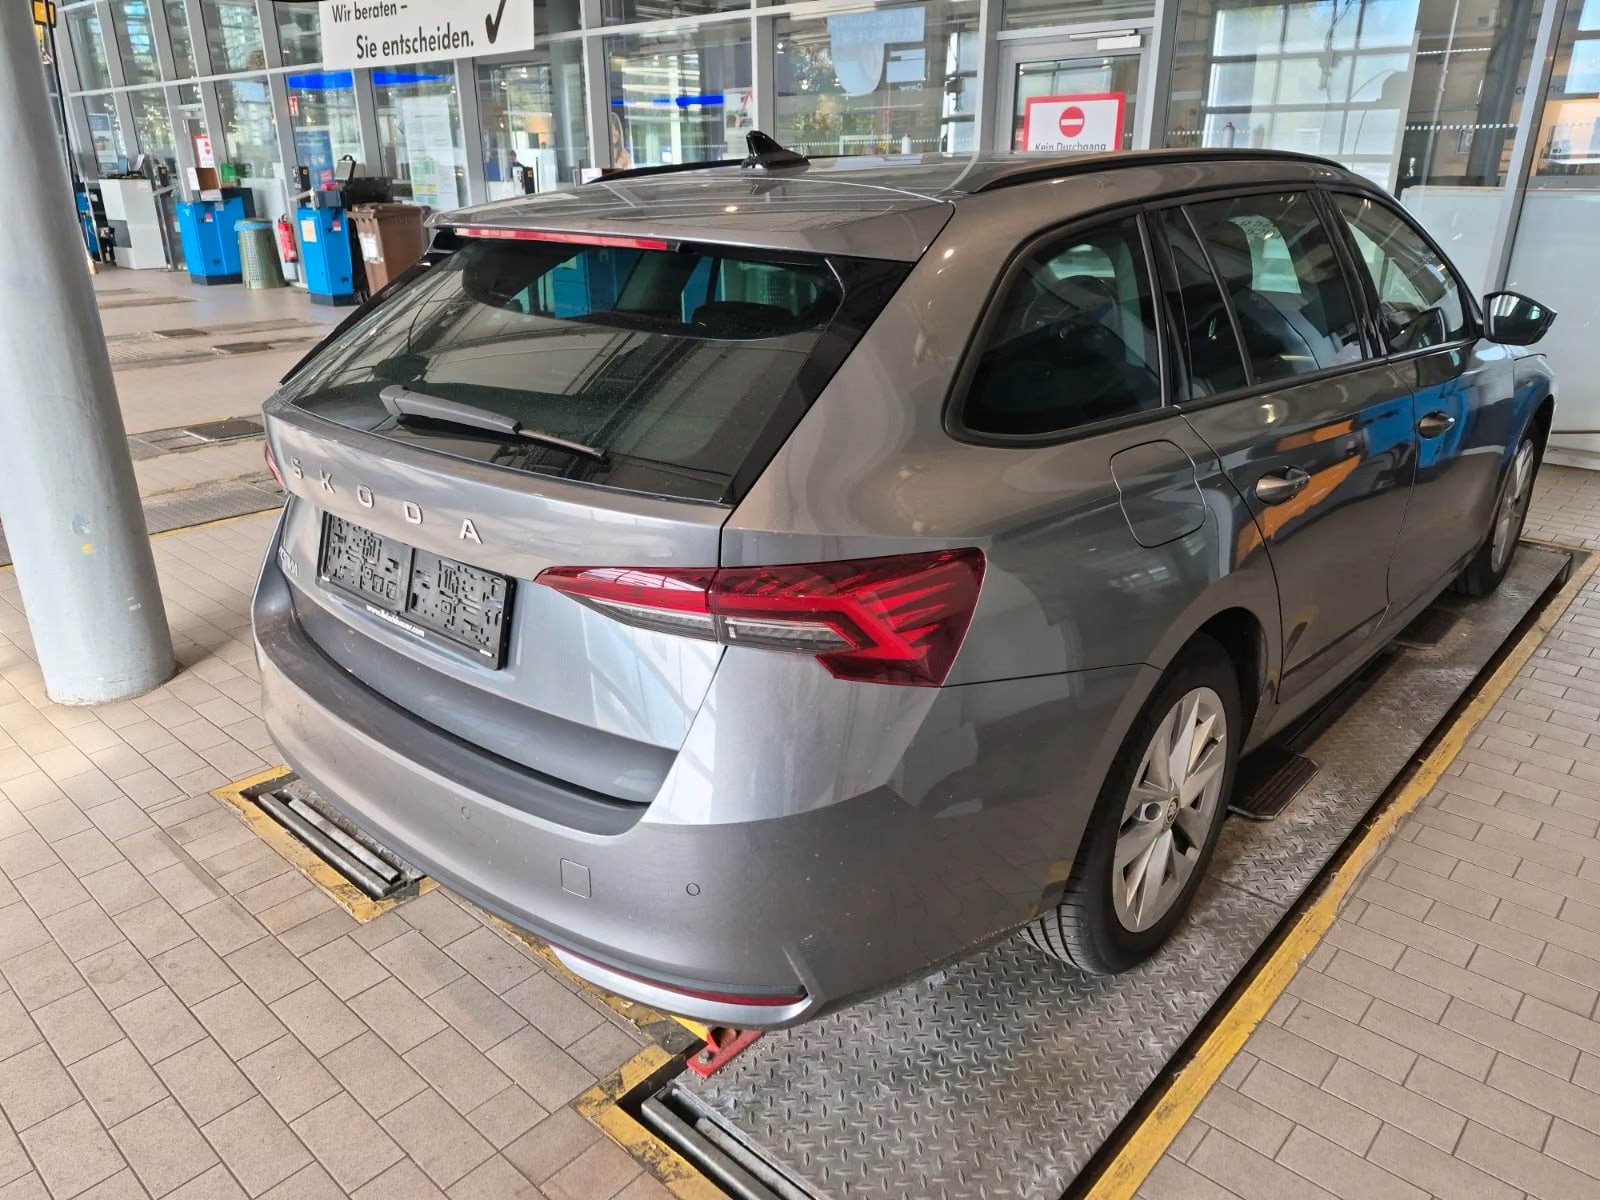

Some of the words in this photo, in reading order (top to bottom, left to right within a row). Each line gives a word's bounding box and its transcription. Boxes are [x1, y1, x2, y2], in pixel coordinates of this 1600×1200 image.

[332, 5, 351, 23] Wir
[354, 2, 397, 20] beraten
[356, 34, 377, 59] Sie
[382, 22, 474, 57] entscheiden.
